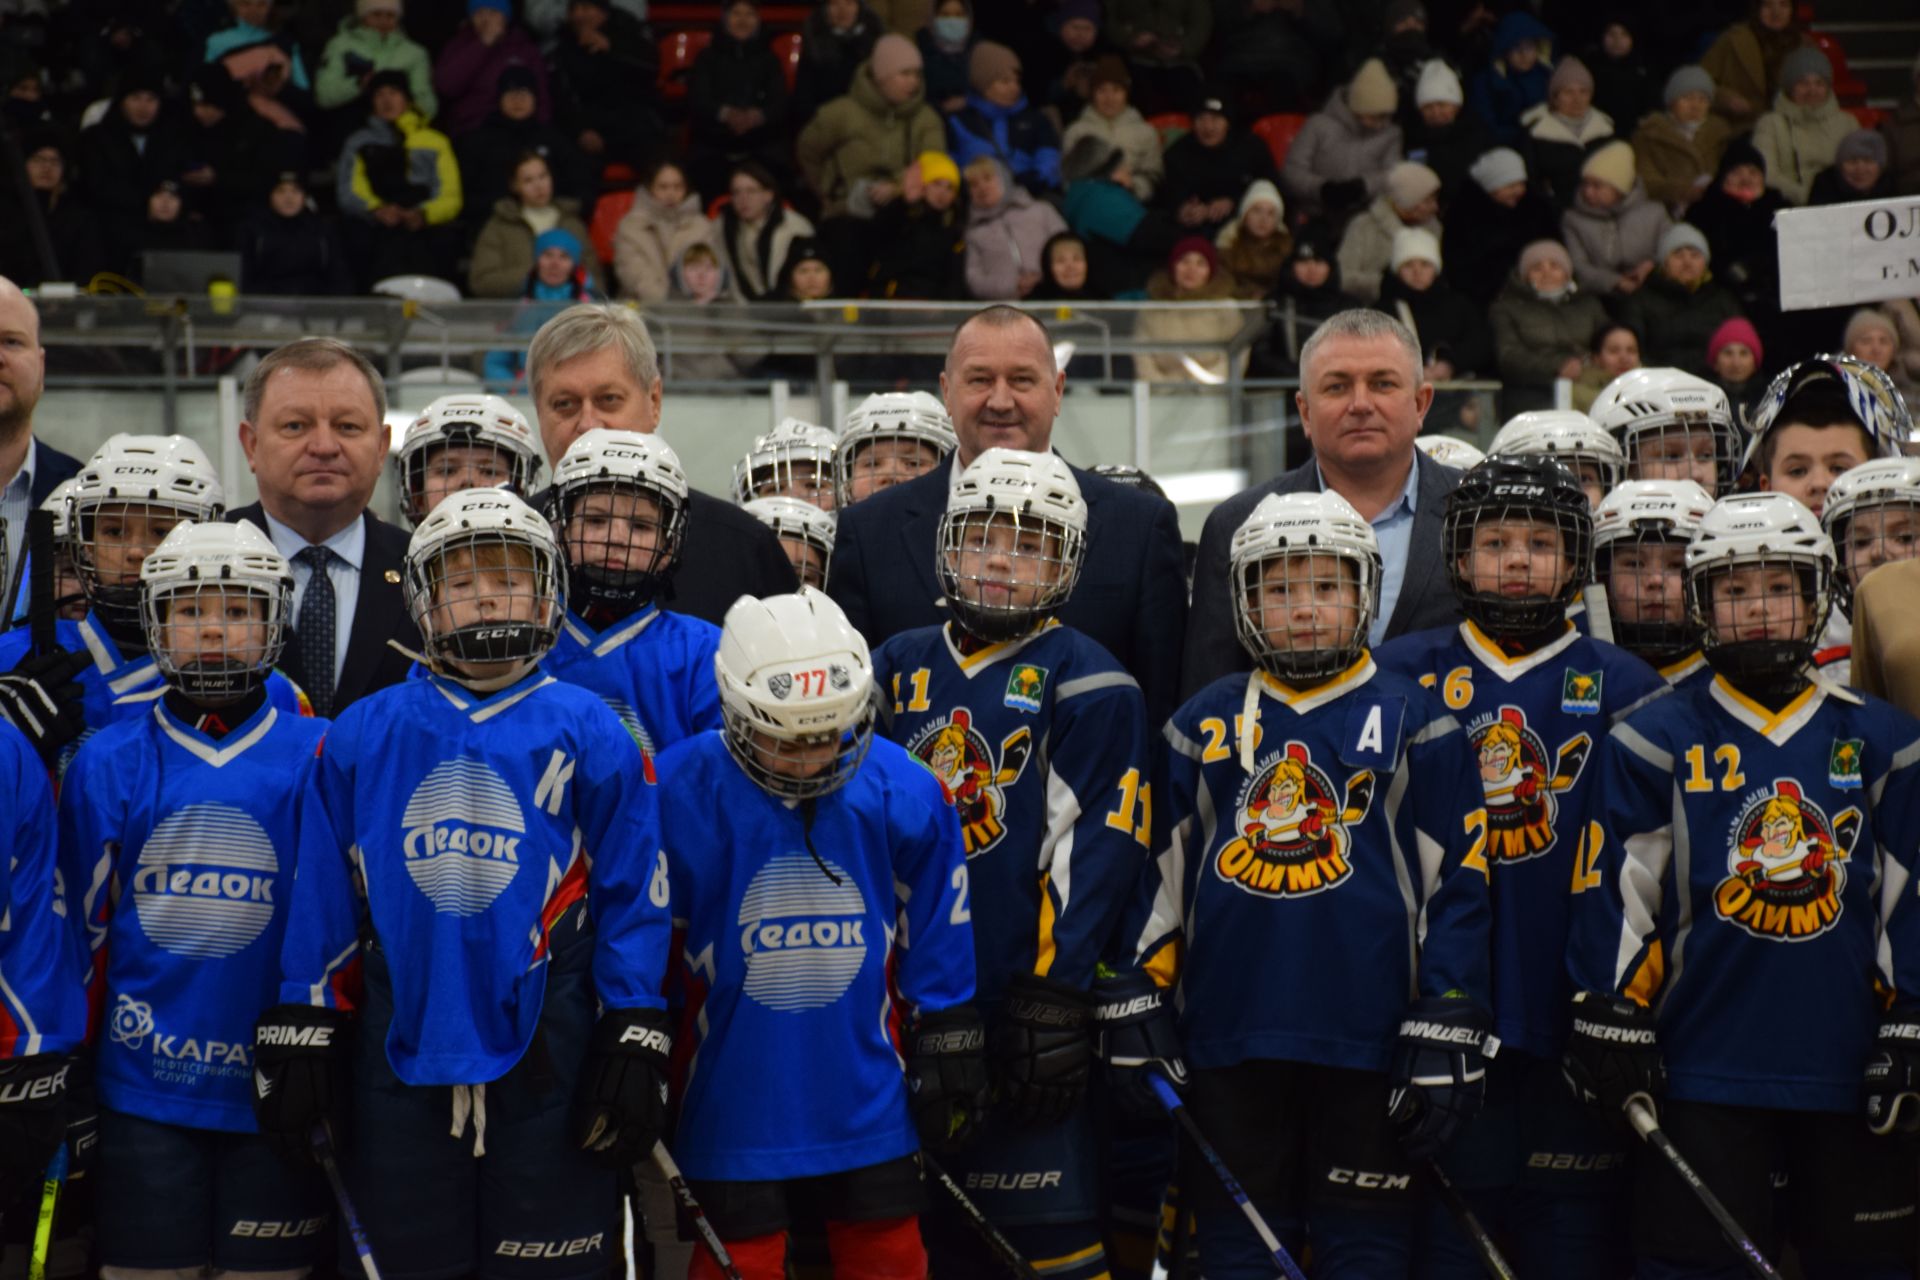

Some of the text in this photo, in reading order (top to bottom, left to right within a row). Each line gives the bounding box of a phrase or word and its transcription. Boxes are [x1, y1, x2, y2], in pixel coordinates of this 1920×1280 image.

[442, 409, 484, 417] CCM
[868, 409, 911, 417] BAUER
[602, 449, 649, 461] CCM
[114, 466, 159, 476] CCM
[988, 476, 1038, 488] CCM
[1856, 473, 1899, 484] CCM
[1494, 484, 1545, 496] CCM
[461, 502, 511, 512] CCM
[1630, 502, 1677, 511] CCM
[1272, 518, 1321, 529] BAUER
[589, 585, 637, 600] CCM
[475, 628, 521, 641] CCM
[191, 679, 235, 688] BAUER
[794, 669, 827, 698] 77
[797, 712, 838, 725] CCM
[1356, 704, 1383, 754] A
[1684, 743, 1746, 793] 12
[1218, 838, 1349, 892] ОЛИМП
[949, 863, 971, 925] 2
[1717, 877, 1840, 935] ОЛИМП
[257, 1025, 335, 1046] PRIME
[1878, 1023, 1920, 1039] SHE
[153, 1071, 196, 1085] УСЛУГИ
[1528, 1152, 1626, 1172] BAUER
[965, 1170, 1063, 1190] BAUER
[1327, 1166, 1411, 1190] CCM
[230, 1214, 330, 1238] BAUER
[495, 1232, 604, 1258] BAUER
